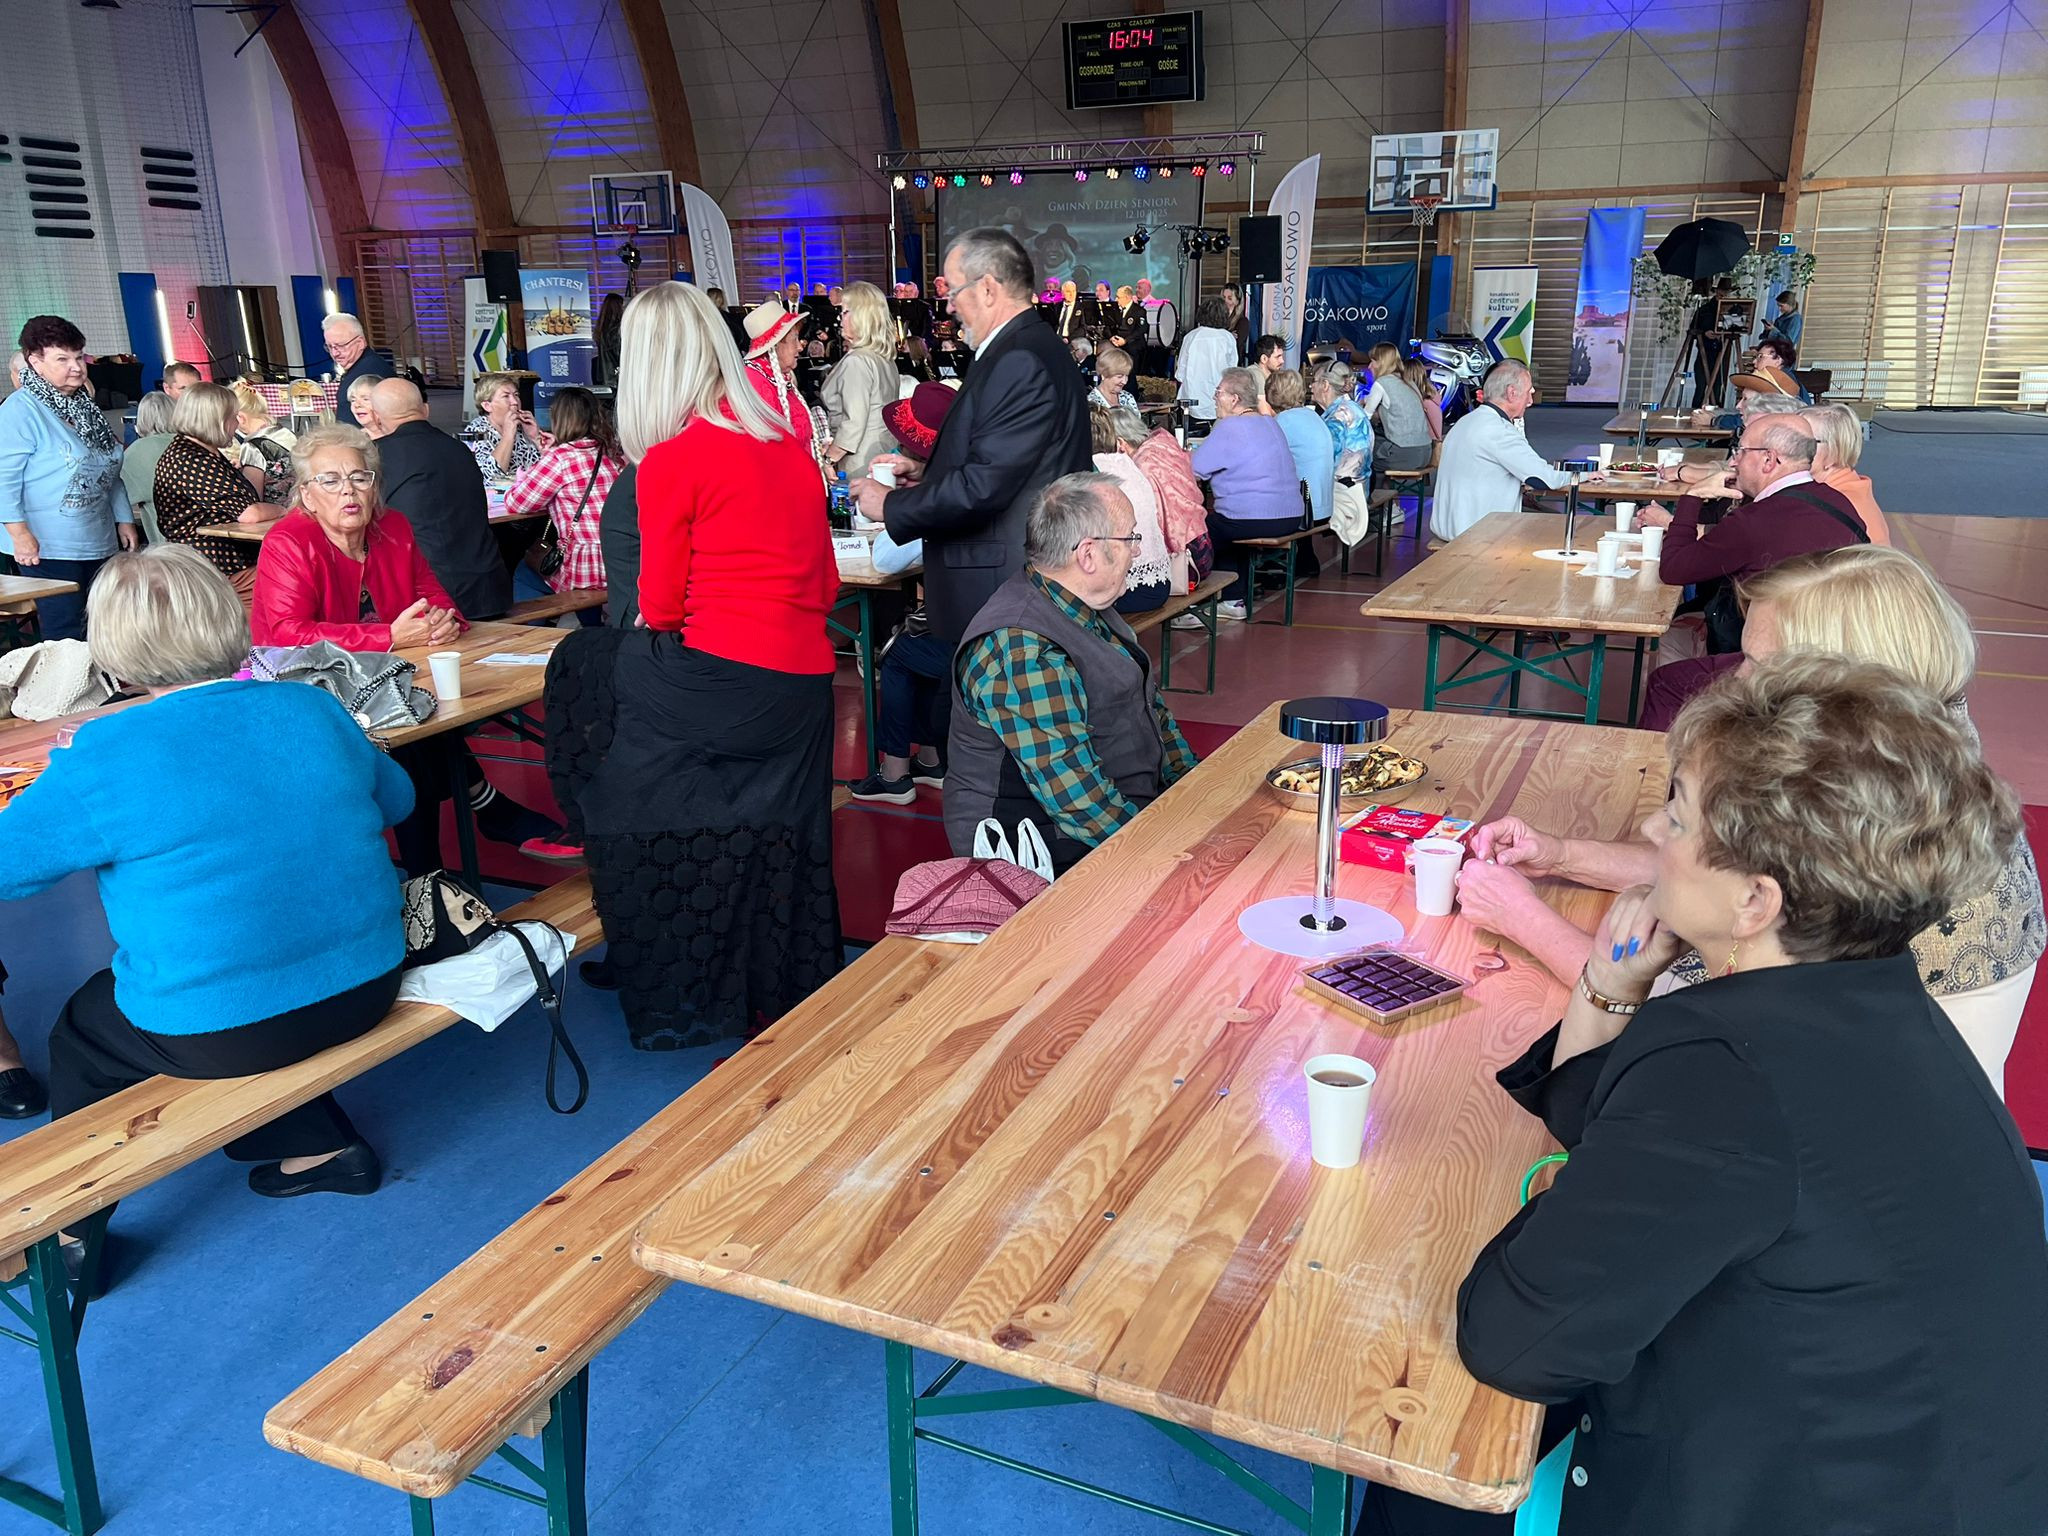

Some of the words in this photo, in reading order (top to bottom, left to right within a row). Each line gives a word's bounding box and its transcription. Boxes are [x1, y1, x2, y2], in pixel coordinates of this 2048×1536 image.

[1106, 21, 1121, 29] CZAS
[1078, 64, 1114, 76] GOSPODARZE
[1120, 60, 1144, 68] TIME-OUT
[1158, 57, 1179, 71] GOŚCIE
[1048, 201, 1091, 212] GMINNY
[1131, 197, 1178, 209] SENIORA
[1282, 210, 1301, 321] KOSAKOWO
[524, 276, 584, 292] CHANTERSI
[1272, 284, 1282, 321] GMINA
[1305, 297, 1329, 307] MINA
[1488, 304, 1519, 312] kultury
[1304, 305, 1388, 322] OSAKOWO
[1366, 323, 1387, 333] sport
